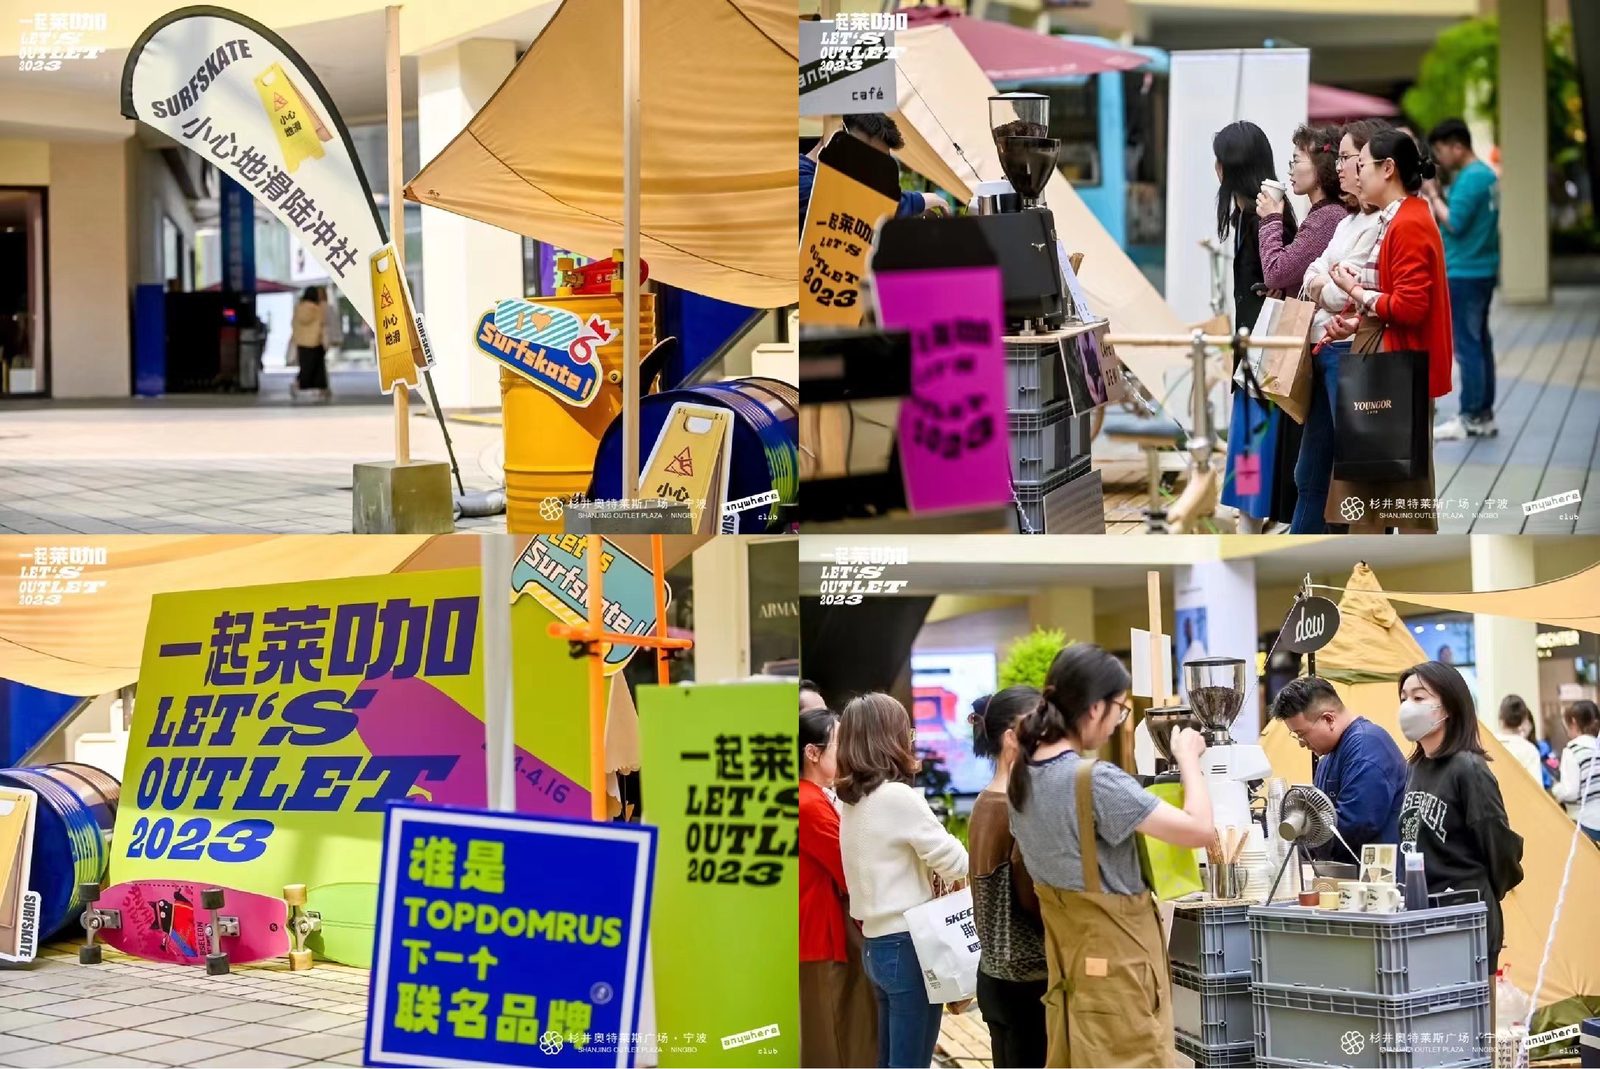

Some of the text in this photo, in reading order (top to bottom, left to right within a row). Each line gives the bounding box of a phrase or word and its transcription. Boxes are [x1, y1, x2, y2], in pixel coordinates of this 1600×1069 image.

[151, 39, 253, 119] SURFSKATE
[852, 87, 884, 101] café
[280, 111, 296, 125] 小心
[284, 121, 302, 137] 地滑
[182, 115, 358, 279] 小心地滑陆冲社
[810, 244, 860, 284] OUTLET
[820, 237, 862, 257] LET'S
[803, 267, 858, 307] 2023
[383, 314, 398, 329] 小心
[385, 330, 400, 345] 地滑
[415, 317, 434, 364] SURFSKATE
[1353, 400, 1392, 411] YOUNGOR
[656, 482, 690, 502] 小心
[547, 534, 616, 573] Lets
[761, 600, 799, 618] ARMA
[1295, 606, 1325, 643] dew
[159, 596, 480, 687] 一起莱咖
[147, 689, 378, 748] LET'S
[681, 733, 799, 781] 一起莱
[136, 755, 461, 812] OUTLET
[126, 816, 275, 863] 2023
[686, 822, 799, 857] OUTL
[408, 835, 505, 894] 谁是
[687, 858, 784, 887] 2023
[19, 894, 37, 957] SURFSKATE
[403, 896, 622, 948] TOPDOMRUS
[402, 939, 498, 982] 下一个
[394, 982, 592, 1050] 联名品牌
